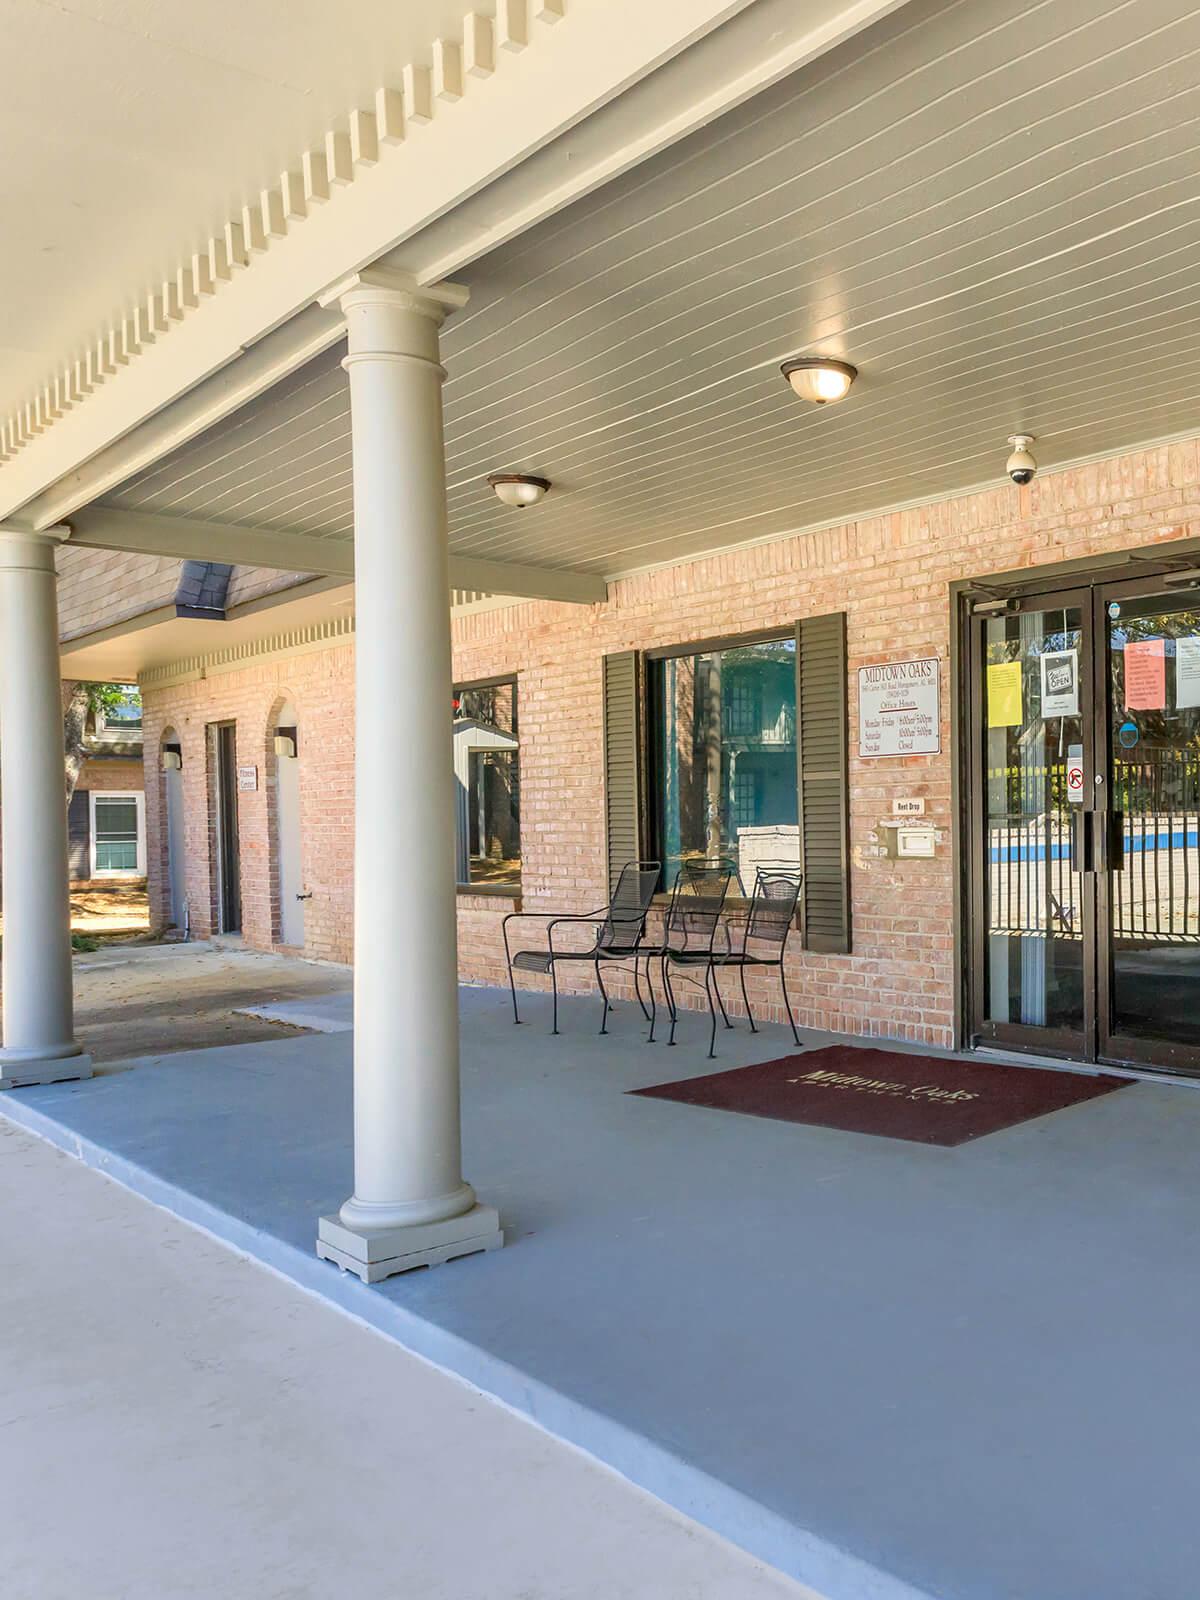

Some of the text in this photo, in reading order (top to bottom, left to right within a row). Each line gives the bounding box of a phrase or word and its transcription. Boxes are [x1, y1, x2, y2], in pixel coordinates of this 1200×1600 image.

[865, 661, 932, 683] MIDTOWN OAKS
[1051, 676, 1070, 688] OPEN
[881, 699, 916, 709] Office Hours
[898, 739, 913, 750] Closed
[897, 802, 920, 811] Rent Drop
[799, 1070, 980, 1101] Midtown Oaks
